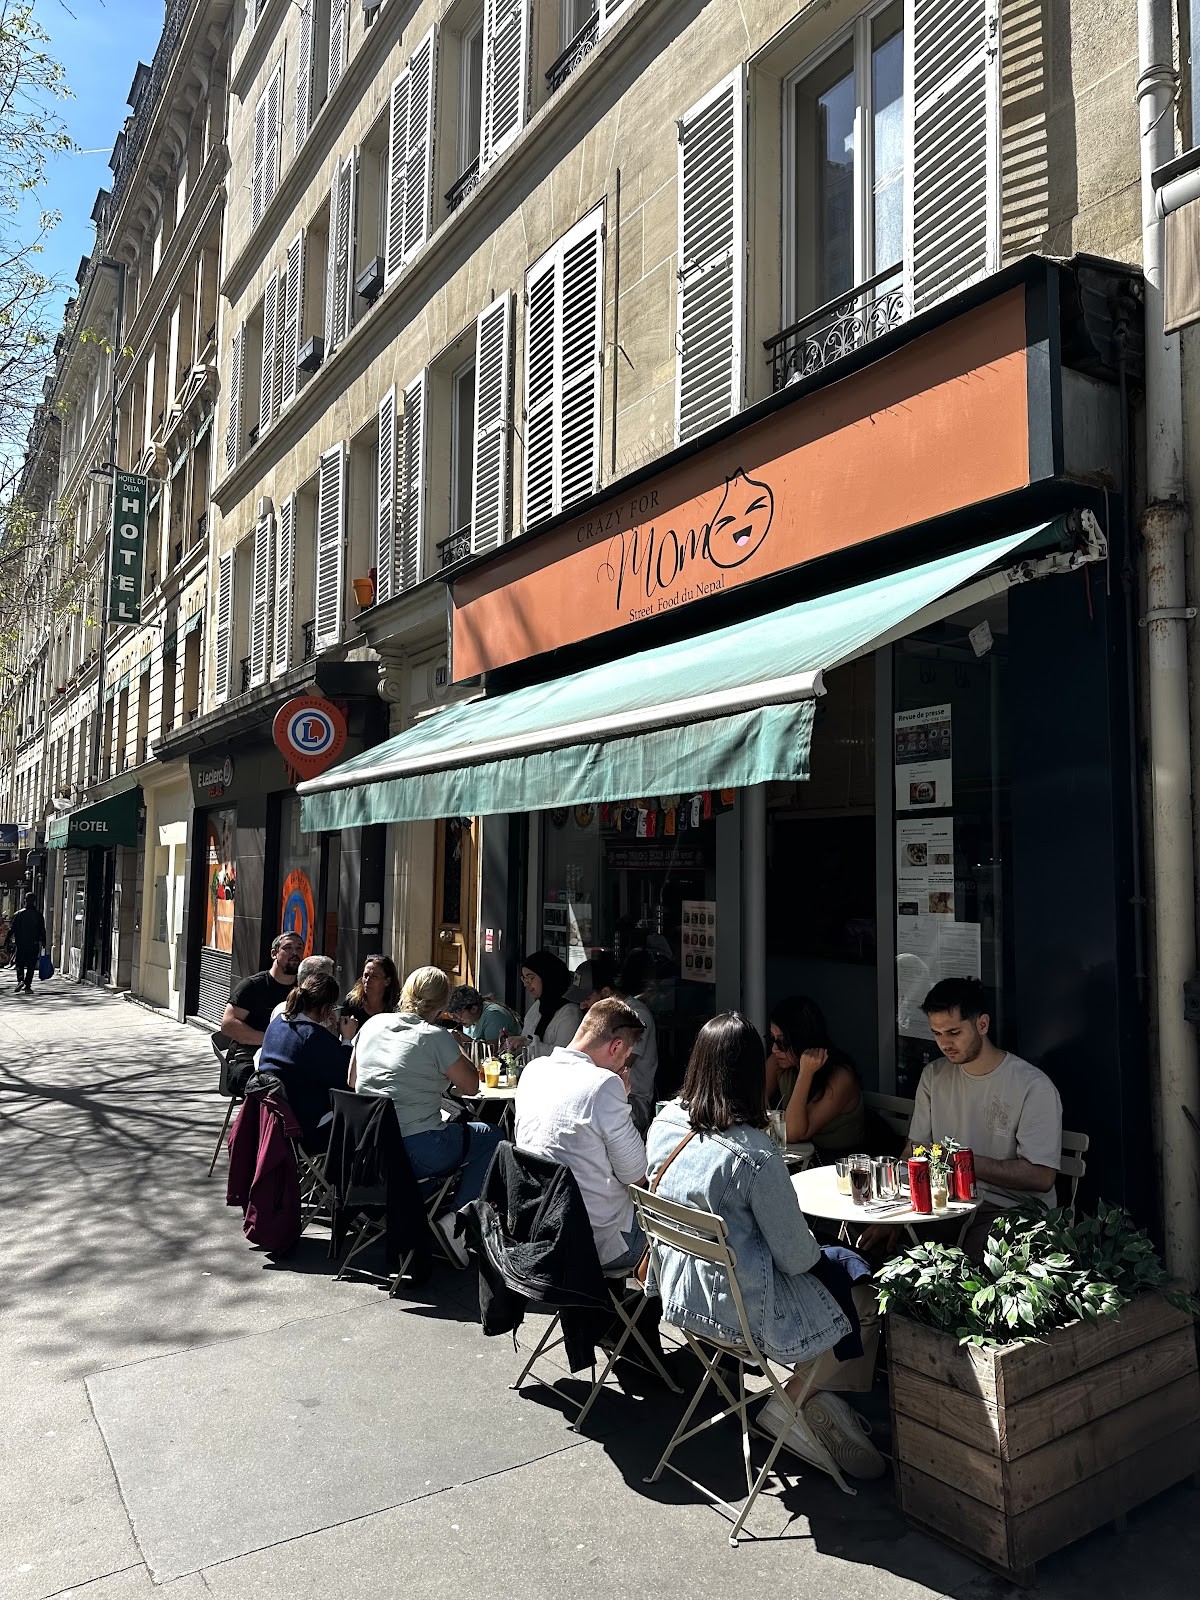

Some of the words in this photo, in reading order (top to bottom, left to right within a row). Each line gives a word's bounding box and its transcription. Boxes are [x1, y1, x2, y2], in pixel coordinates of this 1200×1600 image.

[118, 474, 136, 484] HOTEL
[137, 478, 146, 486] DU
[123, 484, 140, 493] DELTA
[577, 507, 623, 543] CRAZY
[630, 490, 660, 519] FOR
[118, 497, 140, 619] HOTEL
[629, 607, 654, 622] Street
[657, 592, 679, 612] Food
[681, 588, 694, 603] du
[696, 573, 725, 597] Nepal
[898, 714, 916, 722] Revue
[917, 711, 924, 719] de
[925, 709, 945, 718] presse
[301, 722, 318, 743] L
[70, 821, 109, 832] HOTEL
